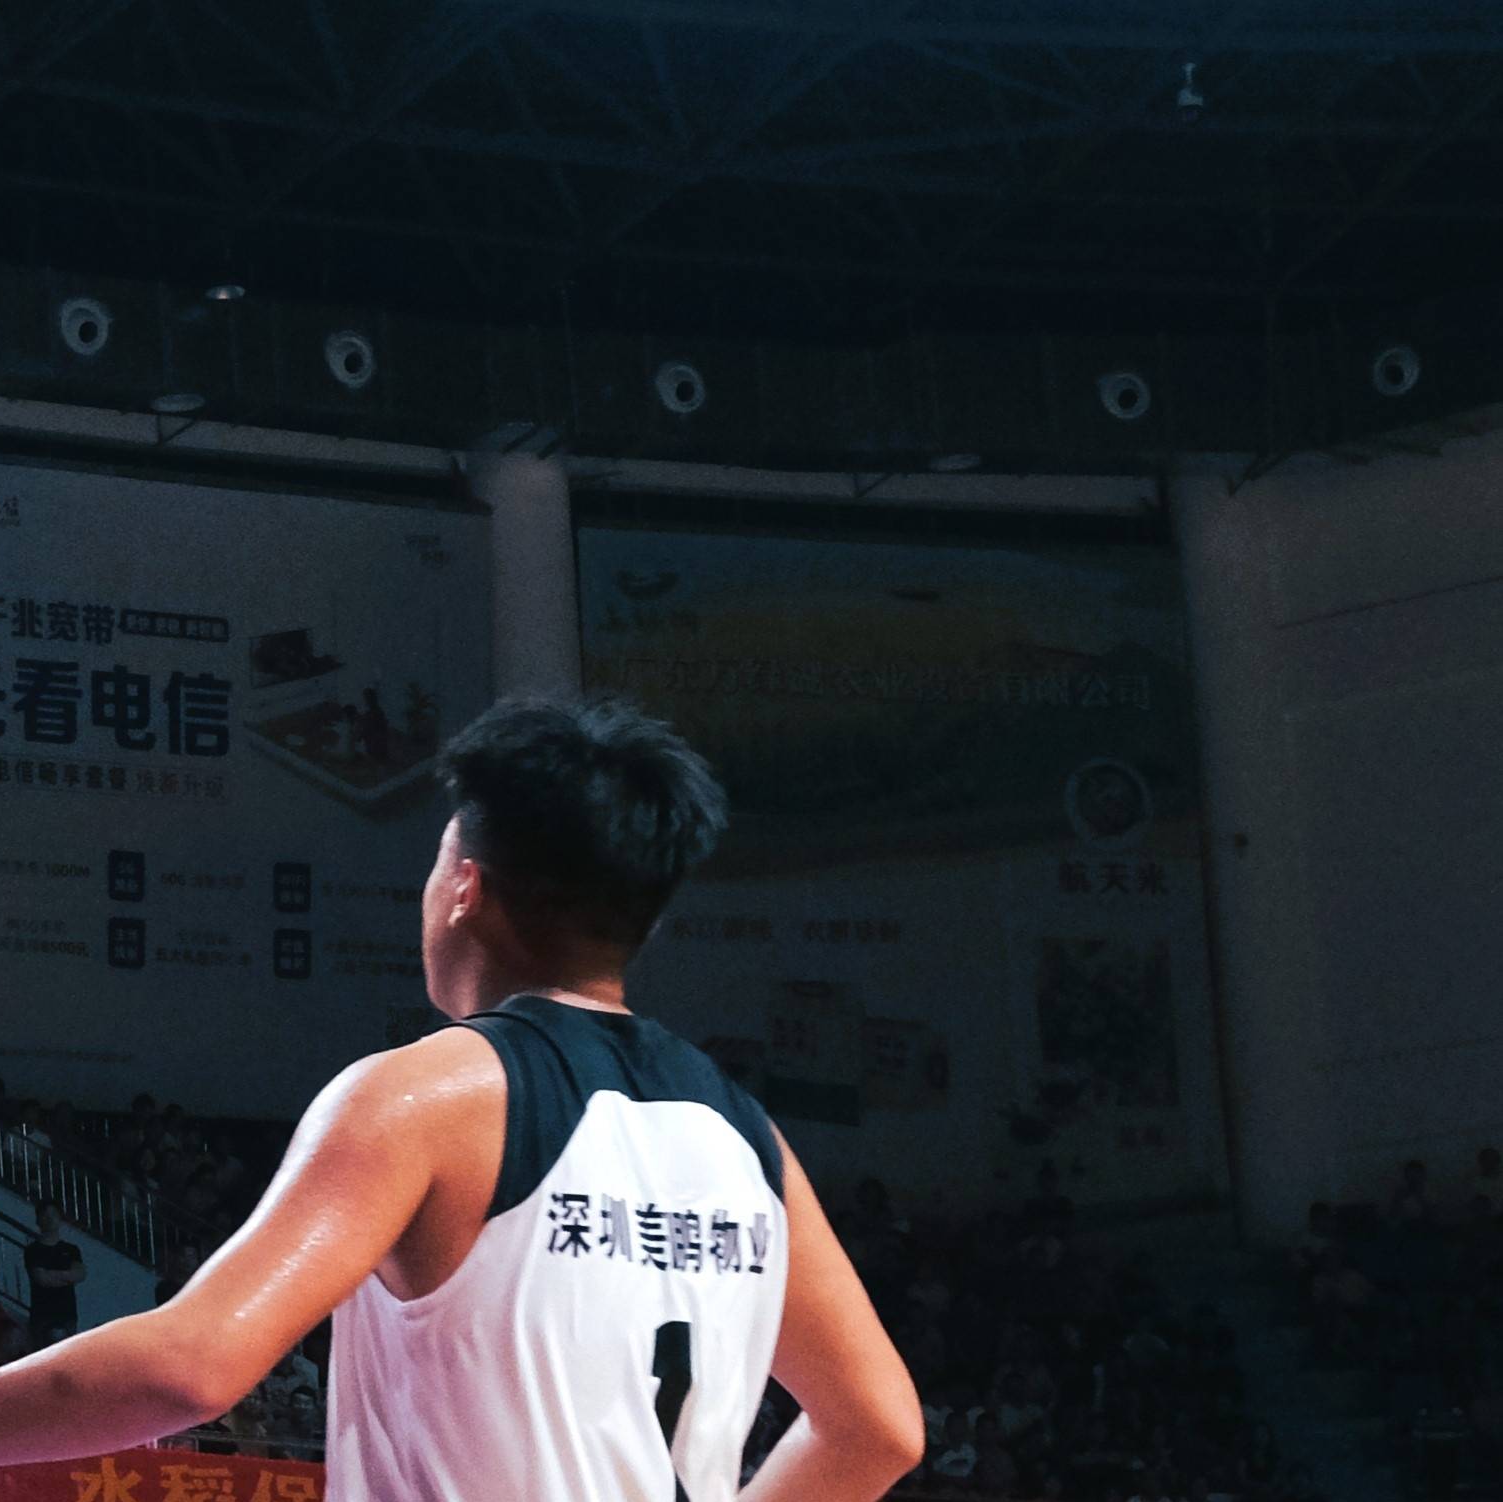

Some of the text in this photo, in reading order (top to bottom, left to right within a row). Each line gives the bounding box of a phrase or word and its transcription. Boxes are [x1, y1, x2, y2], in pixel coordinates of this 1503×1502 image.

[547, 1192, 773, 1275] 深圳美鹏物业
